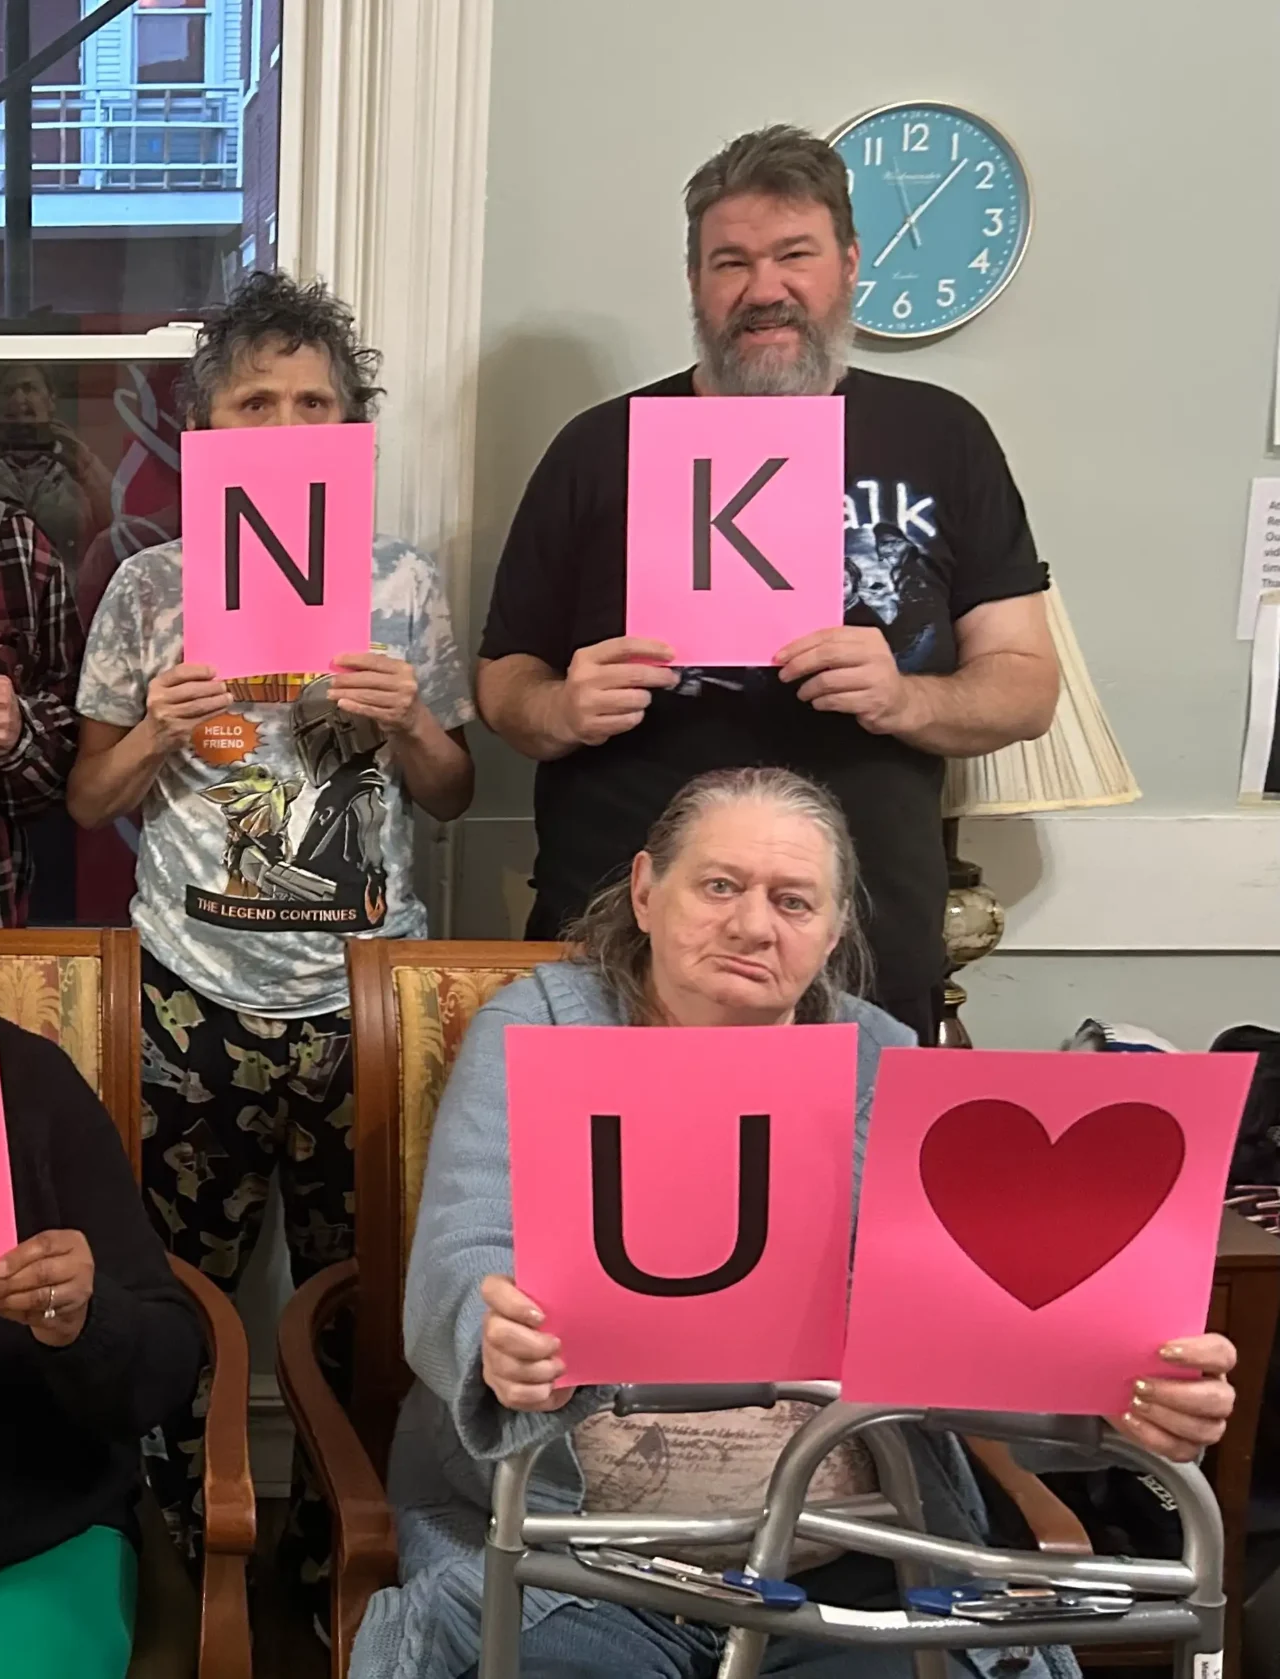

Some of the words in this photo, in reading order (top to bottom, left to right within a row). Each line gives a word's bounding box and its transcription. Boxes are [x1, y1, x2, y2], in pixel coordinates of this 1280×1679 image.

[863, 136, 883, 166] 11
[902, 122, 930, 152] 12
[950, 132, 960, 162] 1
[974, 160, 995, 190] 2
[983, 207, 1004, 237] 3
[967, 247, 991, 275] 4
[856, 280, 877, 308] 7
[892, 290, 913, 320] 6
[935, 278, 956, 308] 5
[694, 459, 792, 590] K
[226, 483, 326, 611] N
[203, 738, 245, 749] FRIEND
[204, 725, 243, 736] HELLO
[197, 897, 219, 914] THE
[221, 903, 276, 921] LEGEND
[280, 908, 357, 922] CONTINUES
[591, 1115, 771, 1297] U
